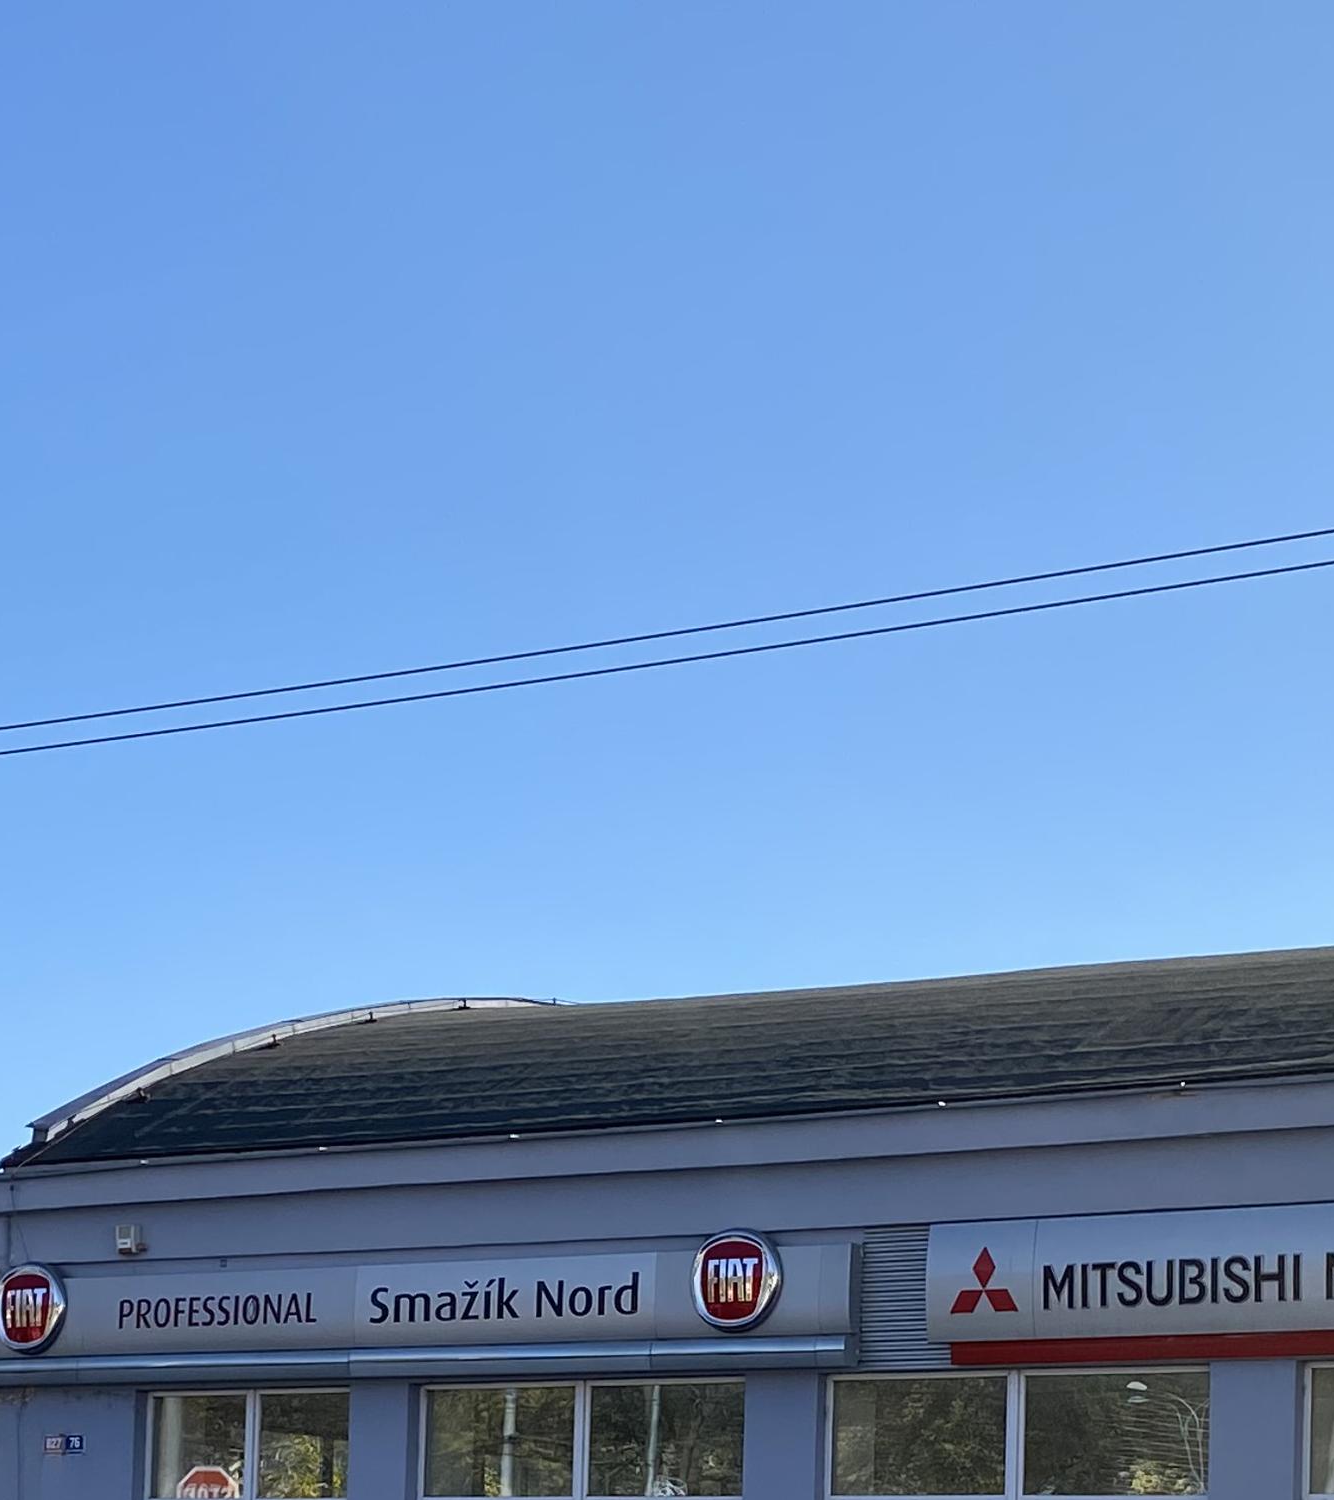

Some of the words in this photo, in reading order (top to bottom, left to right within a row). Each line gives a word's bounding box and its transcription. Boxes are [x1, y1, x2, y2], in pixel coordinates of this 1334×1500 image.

[368, 1277, 520, 1325] Smažík
[535, 1271, 640, 1318] Nord
[707, 1257, 759, 1304] FIAT
[1041, 1252, 1303, 1310] MITSUBISHI
[6, 1287, 47, 1329] FIAT
[118, 1292, 318, 1330] PROFESSIONAL
